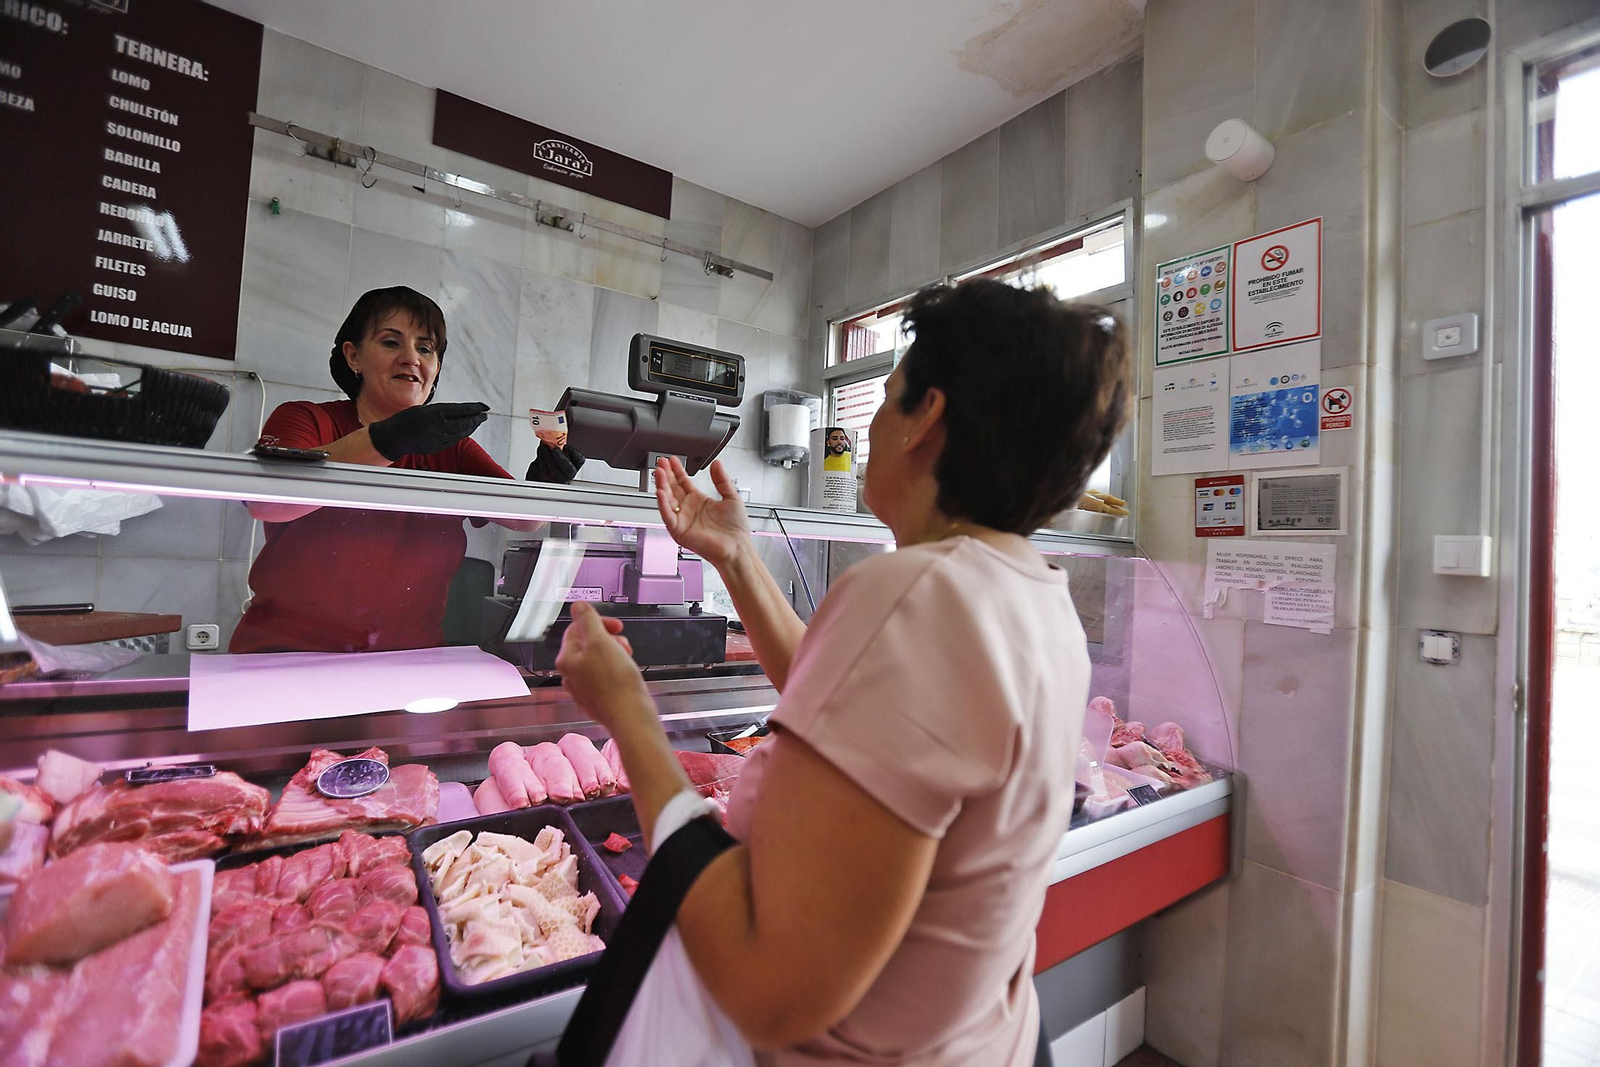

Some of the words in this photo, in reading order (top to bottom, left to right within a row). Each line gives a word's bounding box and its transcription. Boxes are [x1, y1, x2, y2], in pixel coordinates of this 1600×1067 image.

[114, 34, 209, 82] TERNERA:
[111, 69, 151, 91] LOMO
[109, 95, 179, 126] CHULETÓN
[106, 122, 181, 153] SOLOMILLO
[104, 148, 161, 174] BABILLA
[545, 149, 581, 170] Jara
[102, 175, 157, 200] CADERA
[100, 201, 165, 227] REDONDO
[97, 229, 155, 252] JARRETE
[95, 255, 147, 277] FILETES
[1248, 273, 1280, 285] PROHIBIDO
[1281, 267, 1304, 277] FUMAR
[1248, 279, 1304, 297] ESTABLECIMIENTO
[1273, 277, 1288, 285] ESTE
[93, 283, 137, 302] GUISO
[90, 310, 130, 328] LOMO
[132, 317, 150, 331] DE
[151, 320, 193, 338] AGUJA
[532, 415, 540, 426] 10
[1322, 415, 1351, 423] PROHIBIDO
[1325, 421, 1346, 429] PERROS
